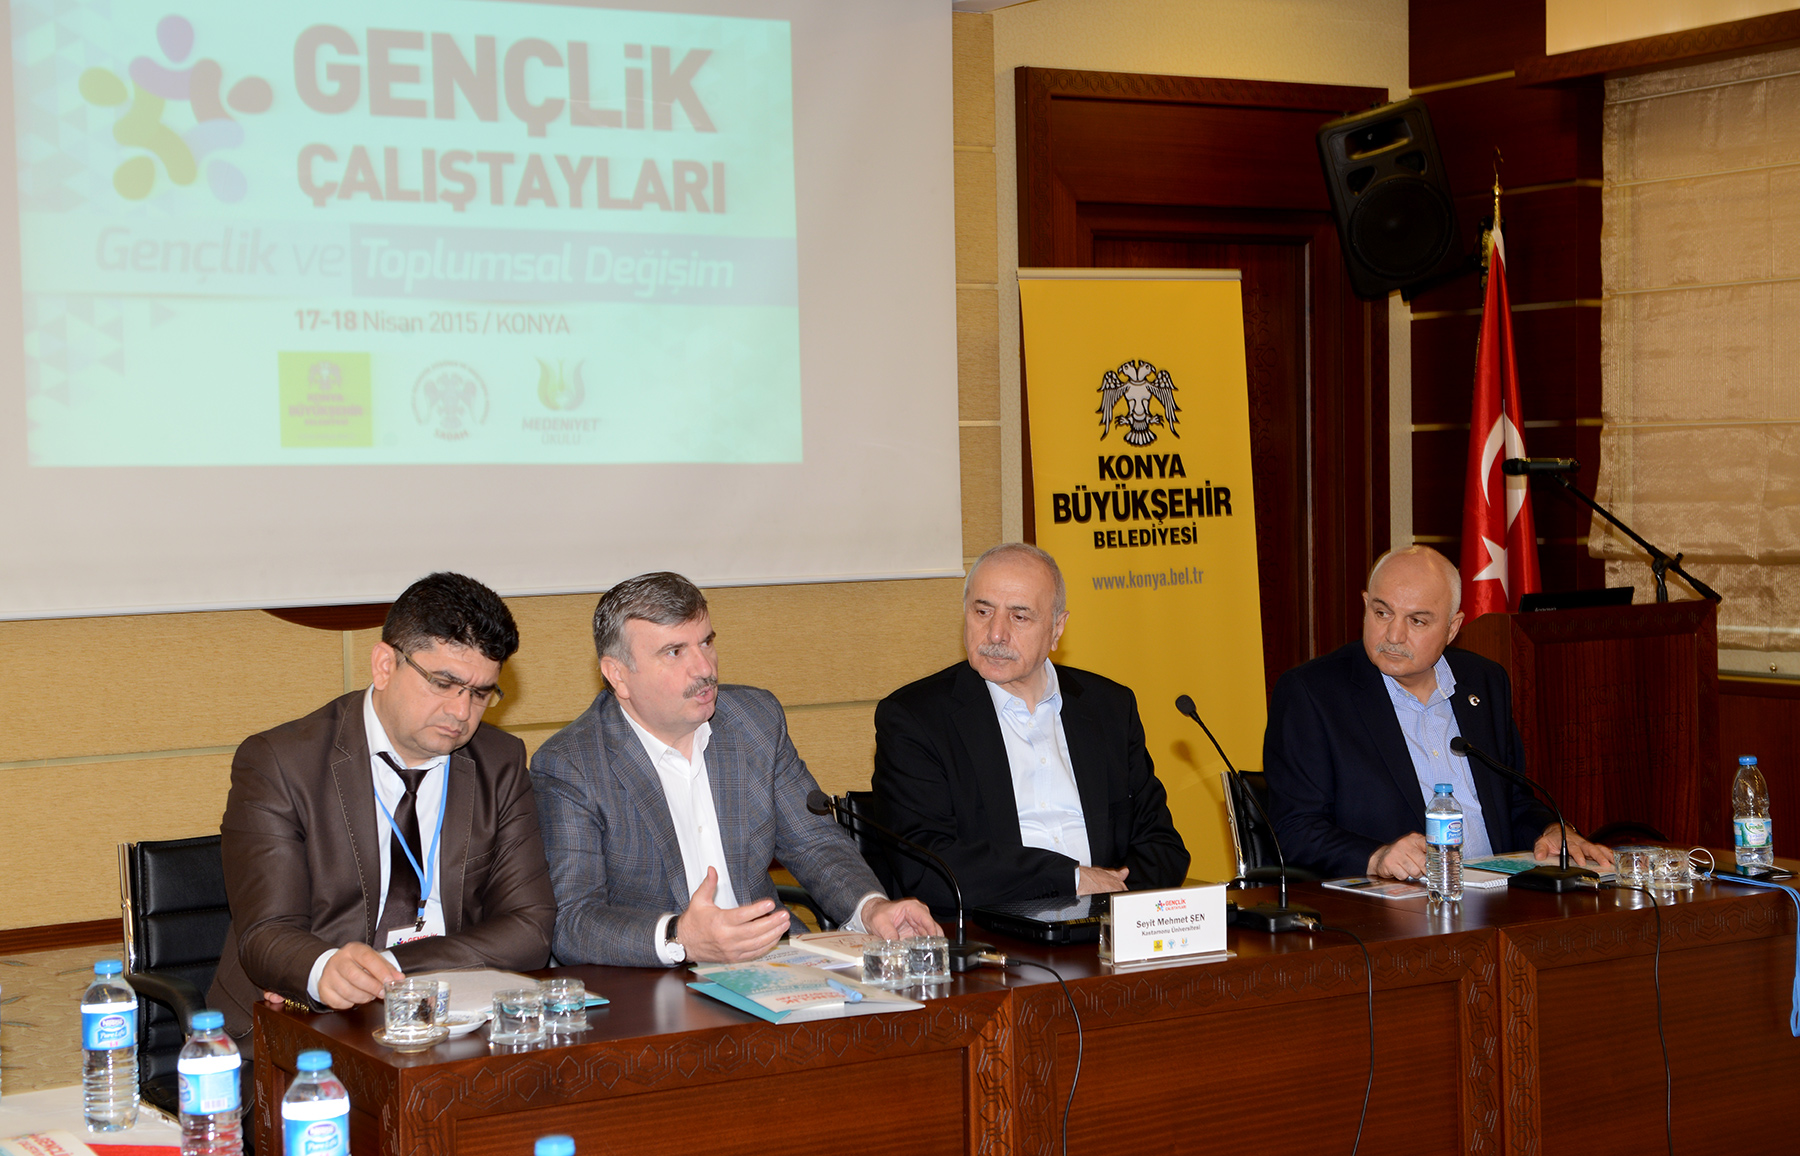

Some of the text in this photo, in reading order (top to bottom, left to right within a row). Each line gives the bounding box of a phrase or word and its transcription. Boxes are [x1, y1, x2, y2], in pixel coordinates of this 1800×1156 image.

[297, 142, 726, 215] ÇALIŞTAYLARI
[95, 225, 734, 298] Gençlik ve Toplumsal Değişim
[294, 309, 357, 331] 17-18
[363, 311, 424, 333] Nisan
[429, 312, 479, 334] 2015
[497, 312, 571, 335] KONYA
[1098, 453, 1187, 481] KONYA
[1052, 480, 1233, 525] BÜYÜKŞEHİR
[1093, 522, 1198, 549] BELEDİYESİ
[1092, 566, 1204, 591] www.konya.bel.tr
[1136, 913, 1206, 929] Seyit Mehmet ŞEN
